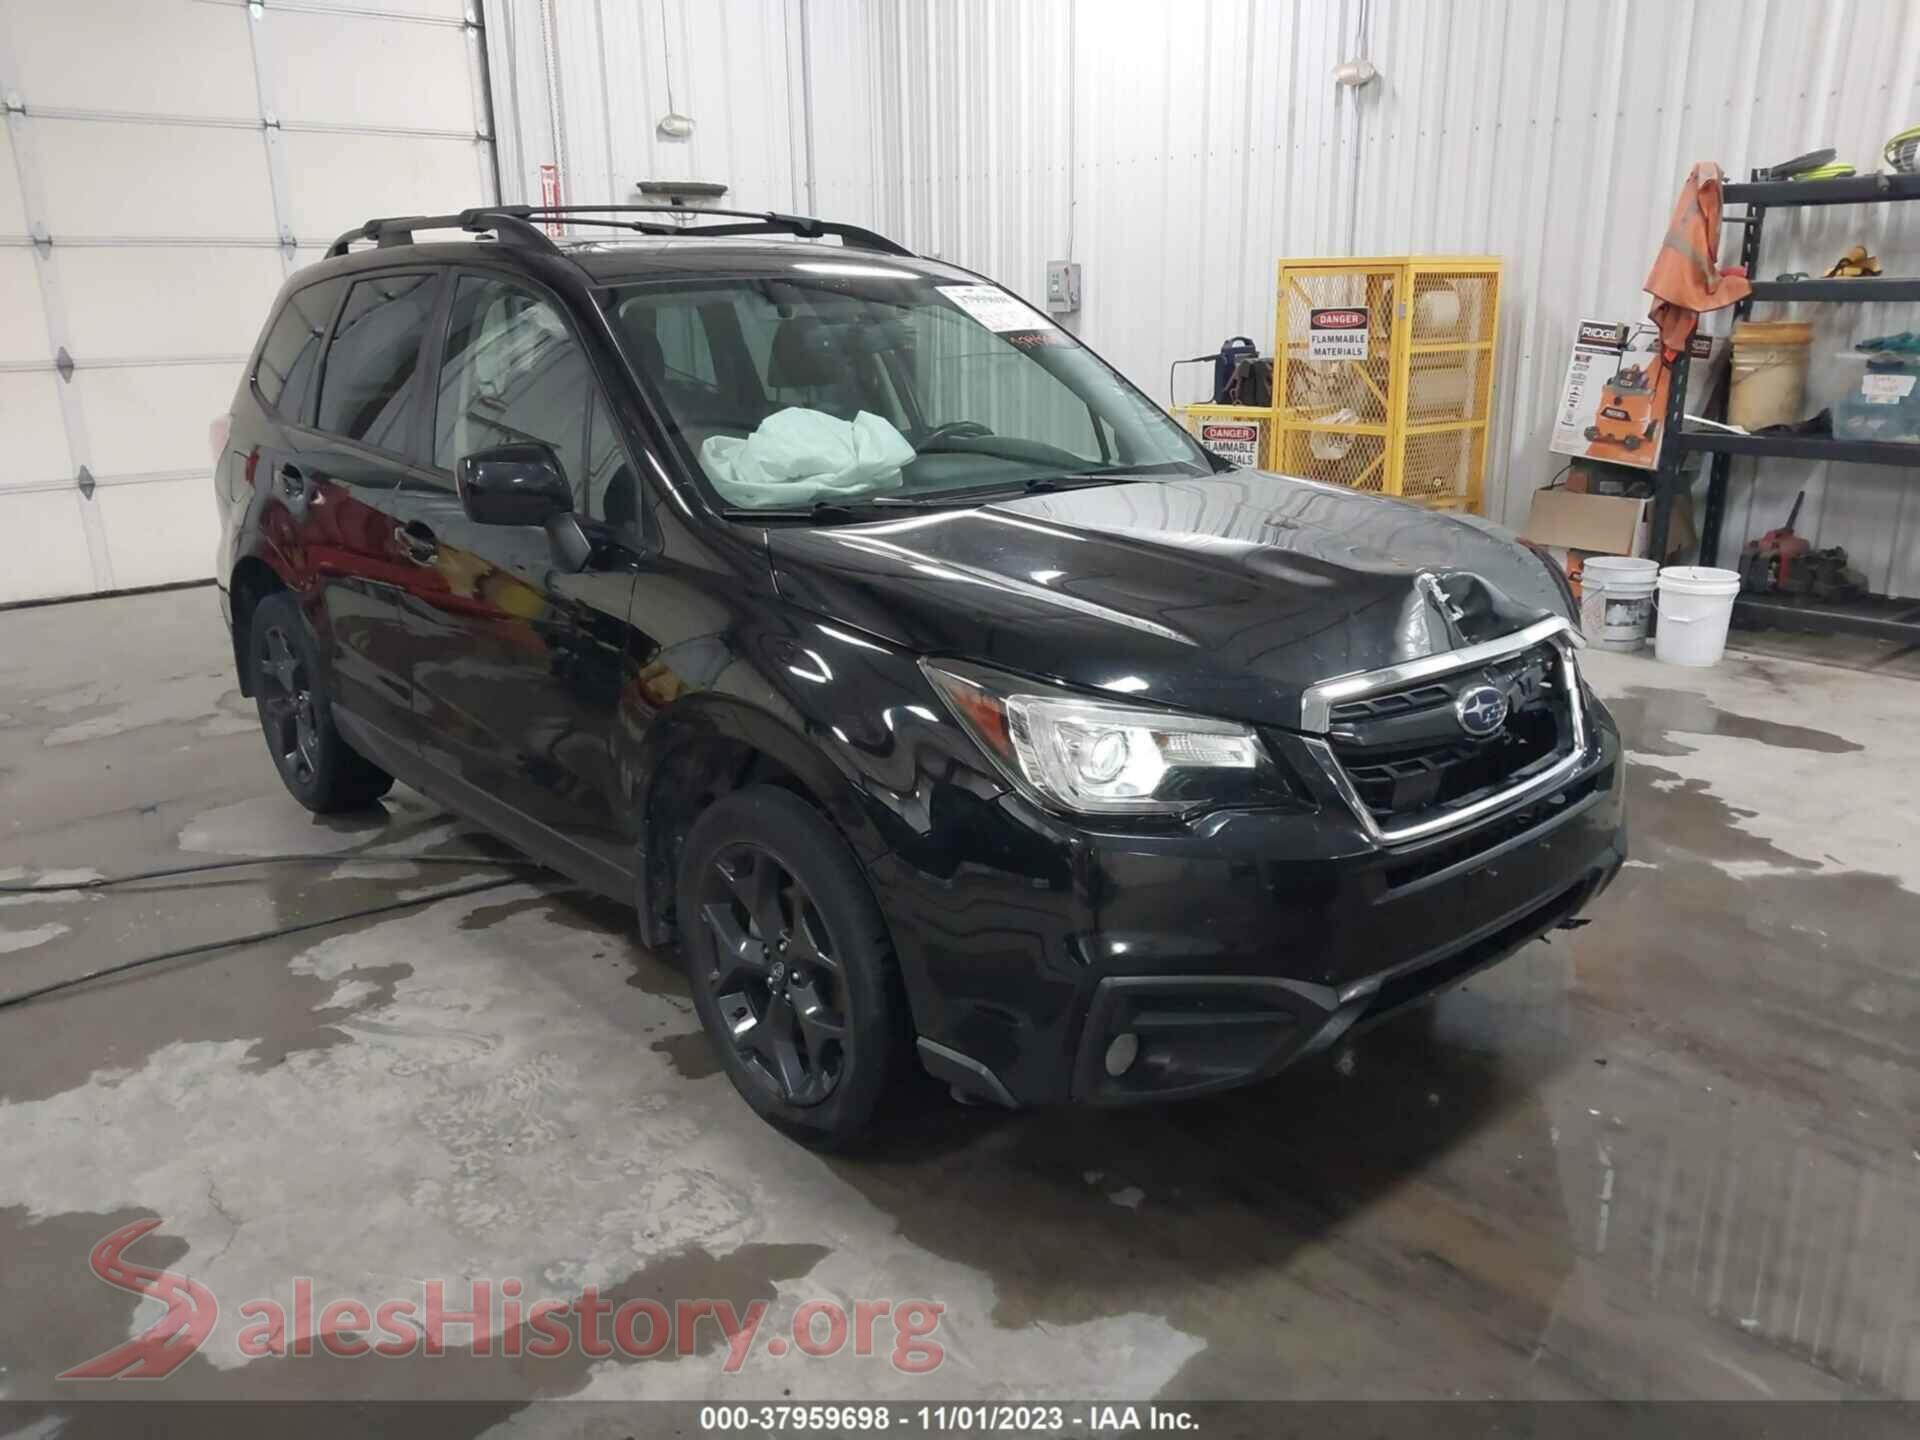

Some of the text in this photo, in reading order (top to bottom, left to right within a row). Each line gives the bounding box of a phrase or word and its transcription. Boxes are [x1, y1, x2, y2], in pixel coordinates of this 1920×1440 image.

[1320, 314, 1359, 324] DANGER
[1582, 325, 1619, 341] RIDGI
[1311, 334, 1365, 344] FLAMMABLE
[1313, 347, 1363, 356] MATERIALS
[1210, 428, 1250, 438] DANGER
